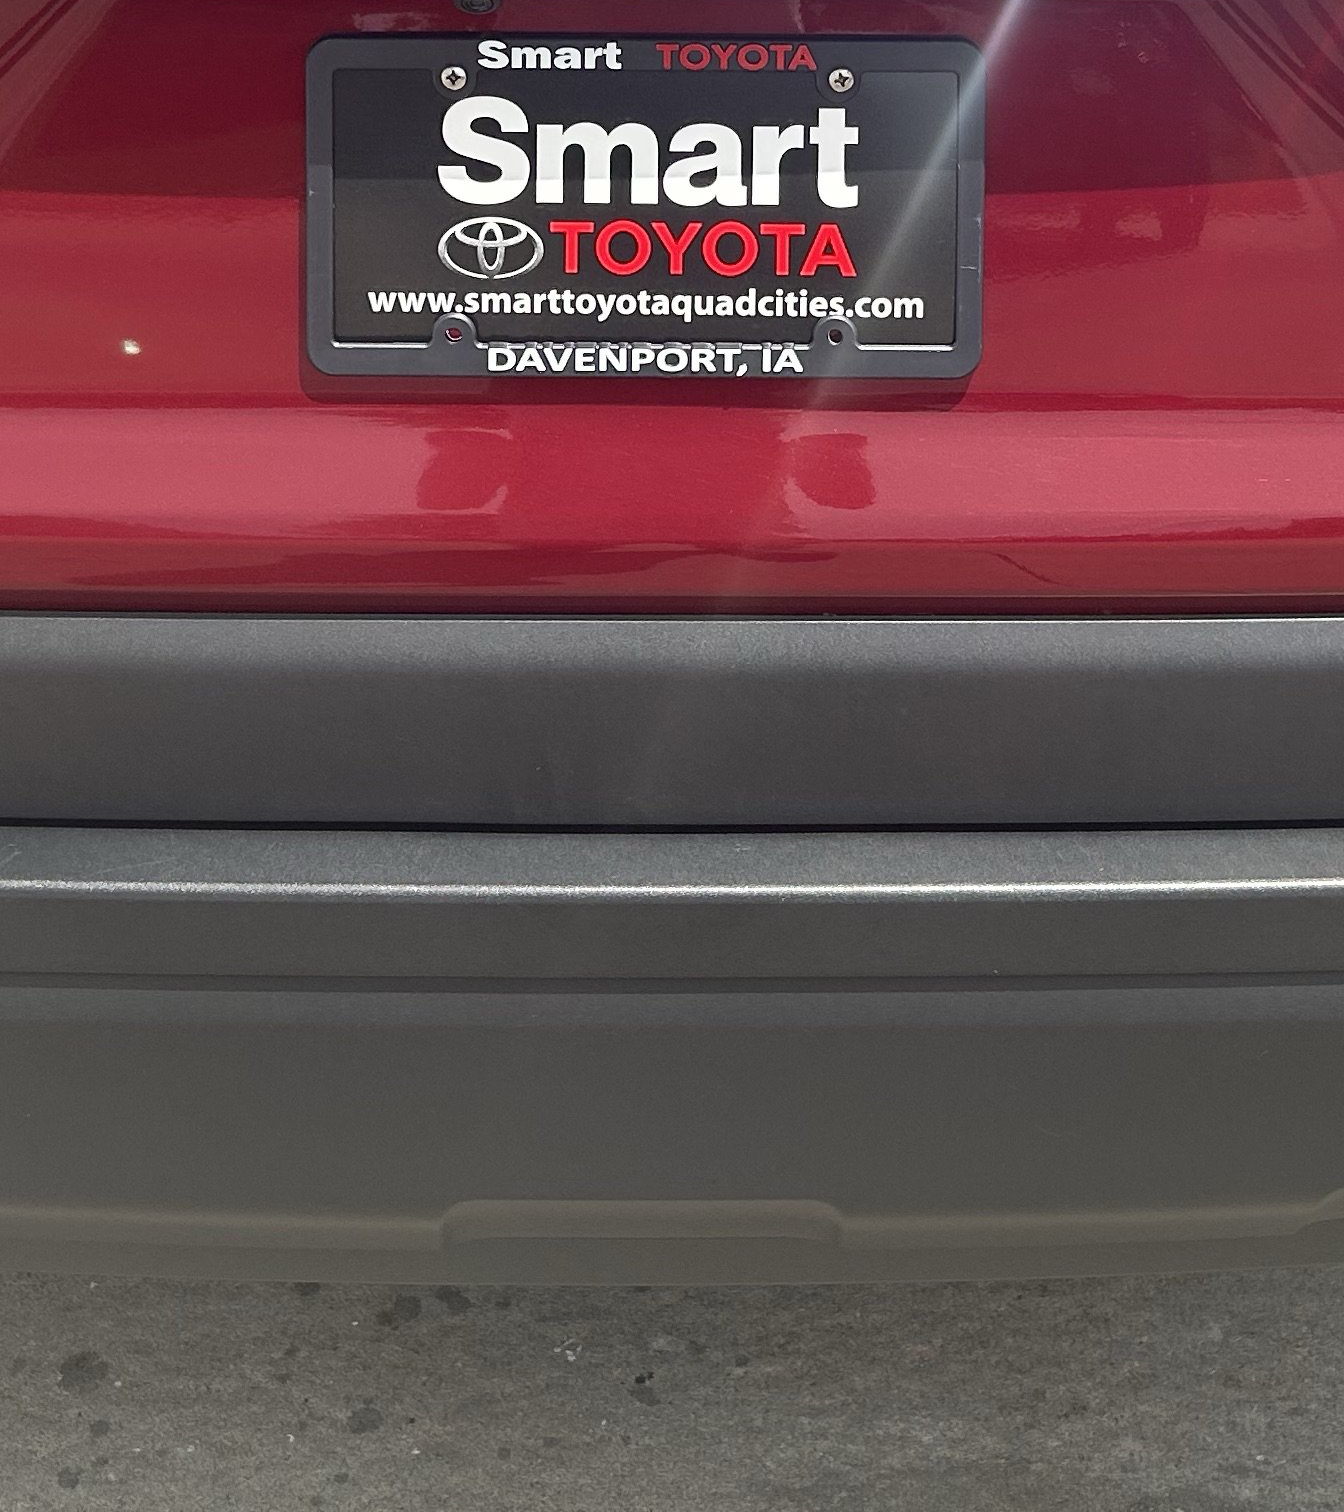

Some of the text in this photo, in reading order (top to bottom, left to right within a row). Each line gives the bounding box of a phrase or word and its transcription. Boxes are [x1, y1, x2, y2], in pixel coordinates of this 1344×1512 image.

[477, 40, 818, 72] Smart TOYOTA
[437, 95, 860, 209] Smart
[549, 219, 857, 278] TOYOTA
[367, 289, 925, 324] www.smarttoyotaquadcities.com
[486, 347, 804, 377] DAVENPORT, IA
